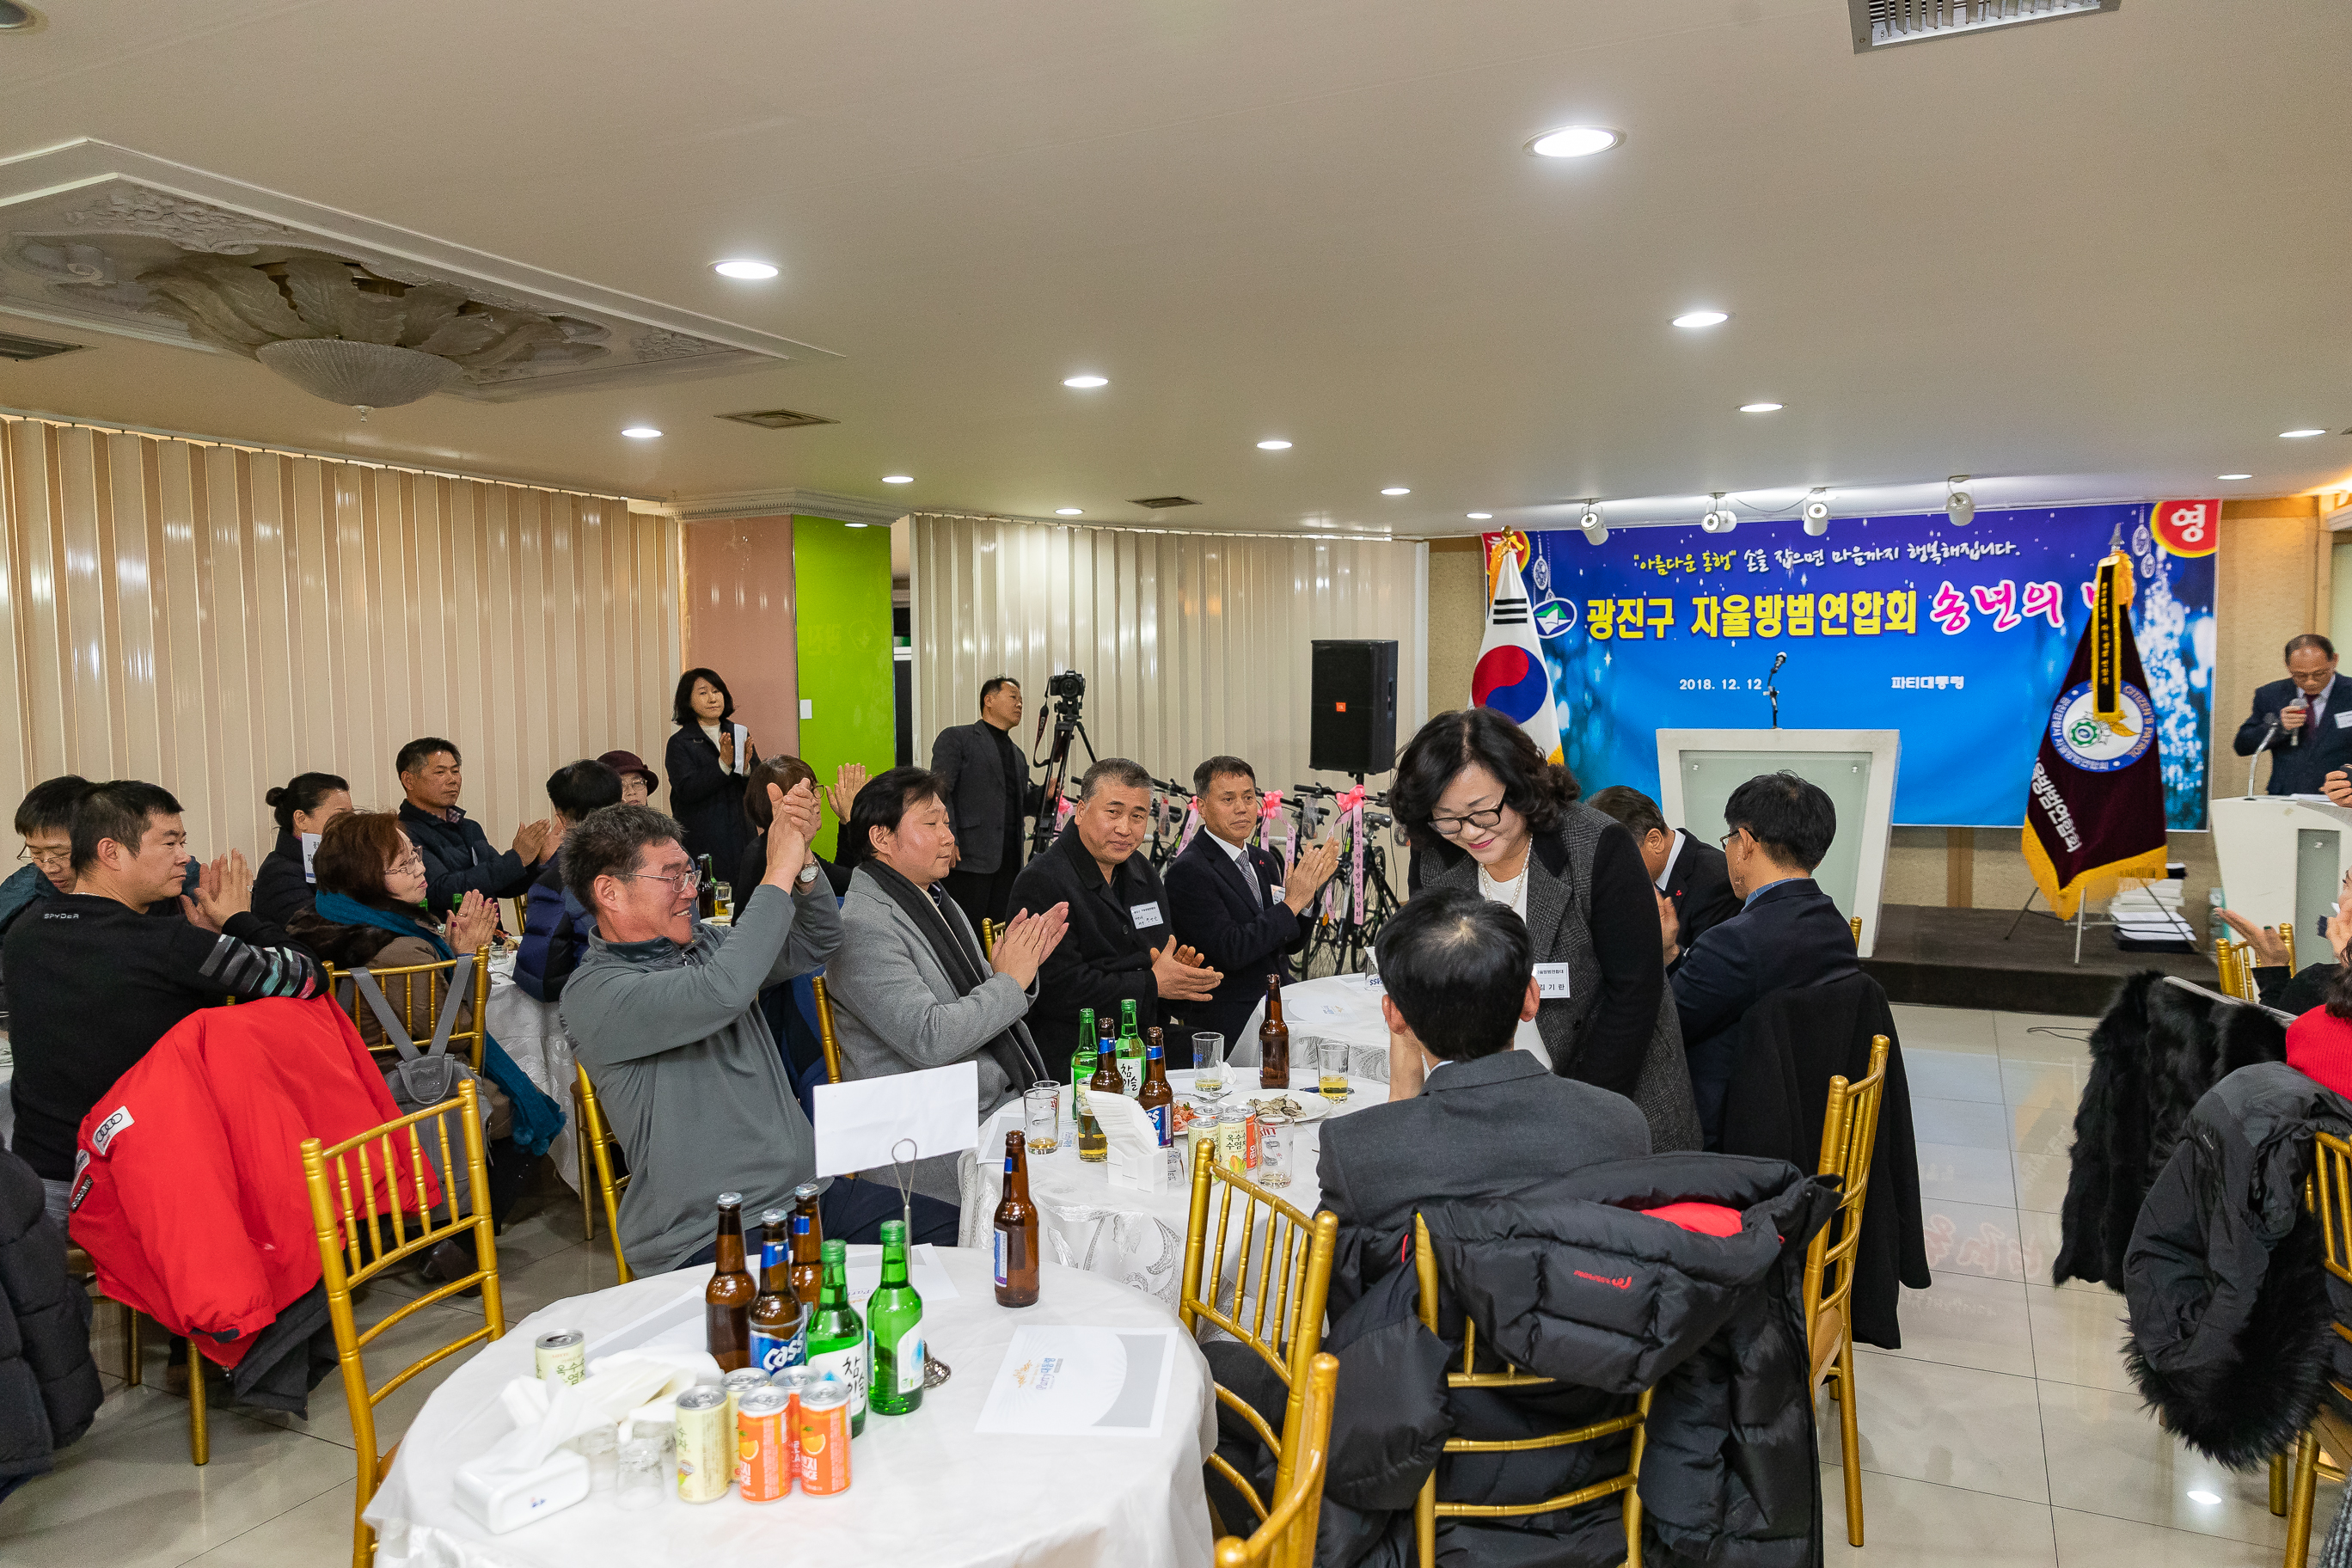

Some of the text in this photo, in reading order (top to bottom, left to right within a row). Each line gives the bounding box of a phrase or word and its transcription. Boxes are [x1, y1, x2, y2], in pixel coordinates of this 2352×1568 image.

[2170, 504, 2208, 542] 영
[1743, 548, 1770, 573] 손을
[1773, 548, 1825, 570] 잡으면
[1832, 544, 1899, 567] 마음까지
[1906, 540, 2021, 566] 행복해집니다.
[1586, 597, 1675, 640] 광진구
[1690, 590, 1917, 639] 자율방범연합회
[1930, 579, 2064, 635] 송년의
[1679, 678, 1762, 690] 2018. 12. 12
[1890, 675, 1965, 689] 파티대통령
